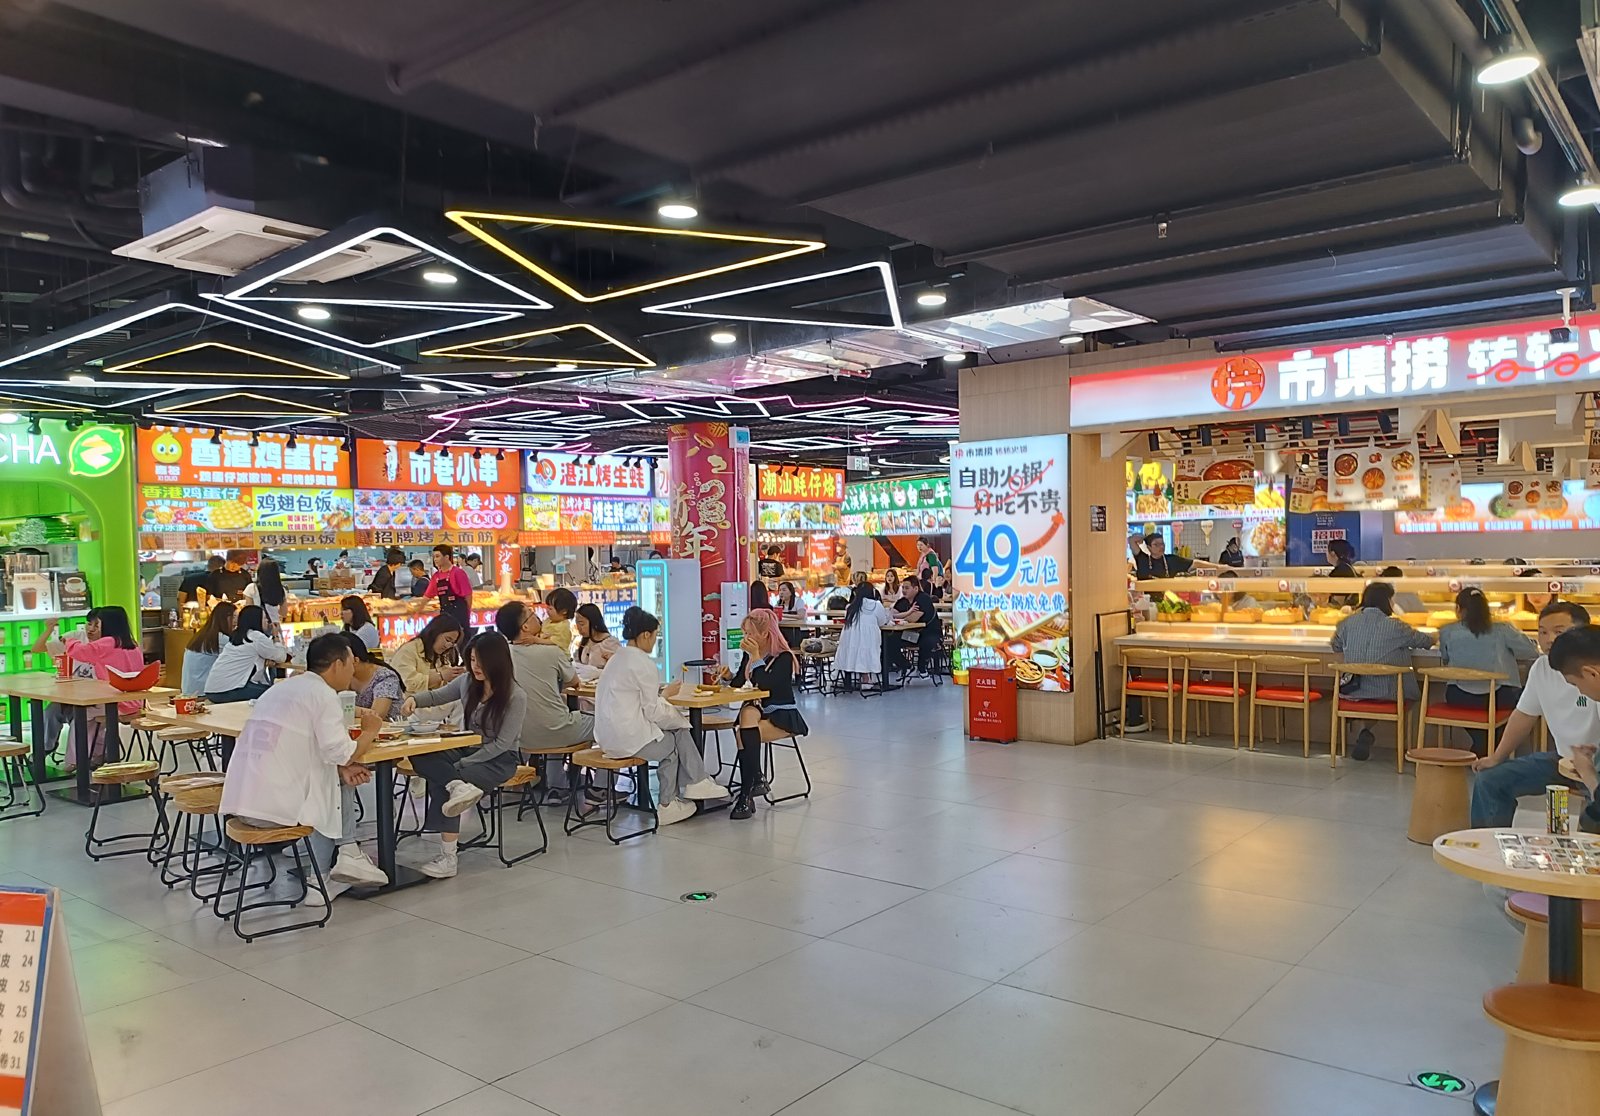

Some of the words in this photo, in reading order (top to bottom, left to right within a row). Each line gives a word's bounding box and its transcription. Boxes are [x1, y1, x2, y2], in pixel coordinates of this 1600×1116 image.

[1279, 336, 1449, 401] 市集捞
[191, 438, 339, 472] 香港鸡蛋仔
[409, 450, 499, 487] 市巷小串
[560, 462, 645, 489] 湛江烤生蚝
[959, 460, 1043, 489] 自助火锅
[142, 485, 240, 499] 香港鸡蛋仔
[762, 469, 836, 498] 潮汕蚝仔烙
[257, 493, 332, 512] 鸡翅包饭
[444, 492, 517, 511] 市巷小串
[974, 489, 1061, 516] 好吃不贵
[258, 533, 336, 545] 鸡翅包饭
[374, 530, 494, 544] 招牌烤大面筋
[955, 523, 1020, 588] 49
[25, 929, 36, 942] 21
[22, 954, 34, 968] 24
[19, 980, 31, 993] 25
[16, 1005, 28, 1018] 25
[13, 1030, 25, 1043] 26
[10, 1056, 21, 1070] 31
